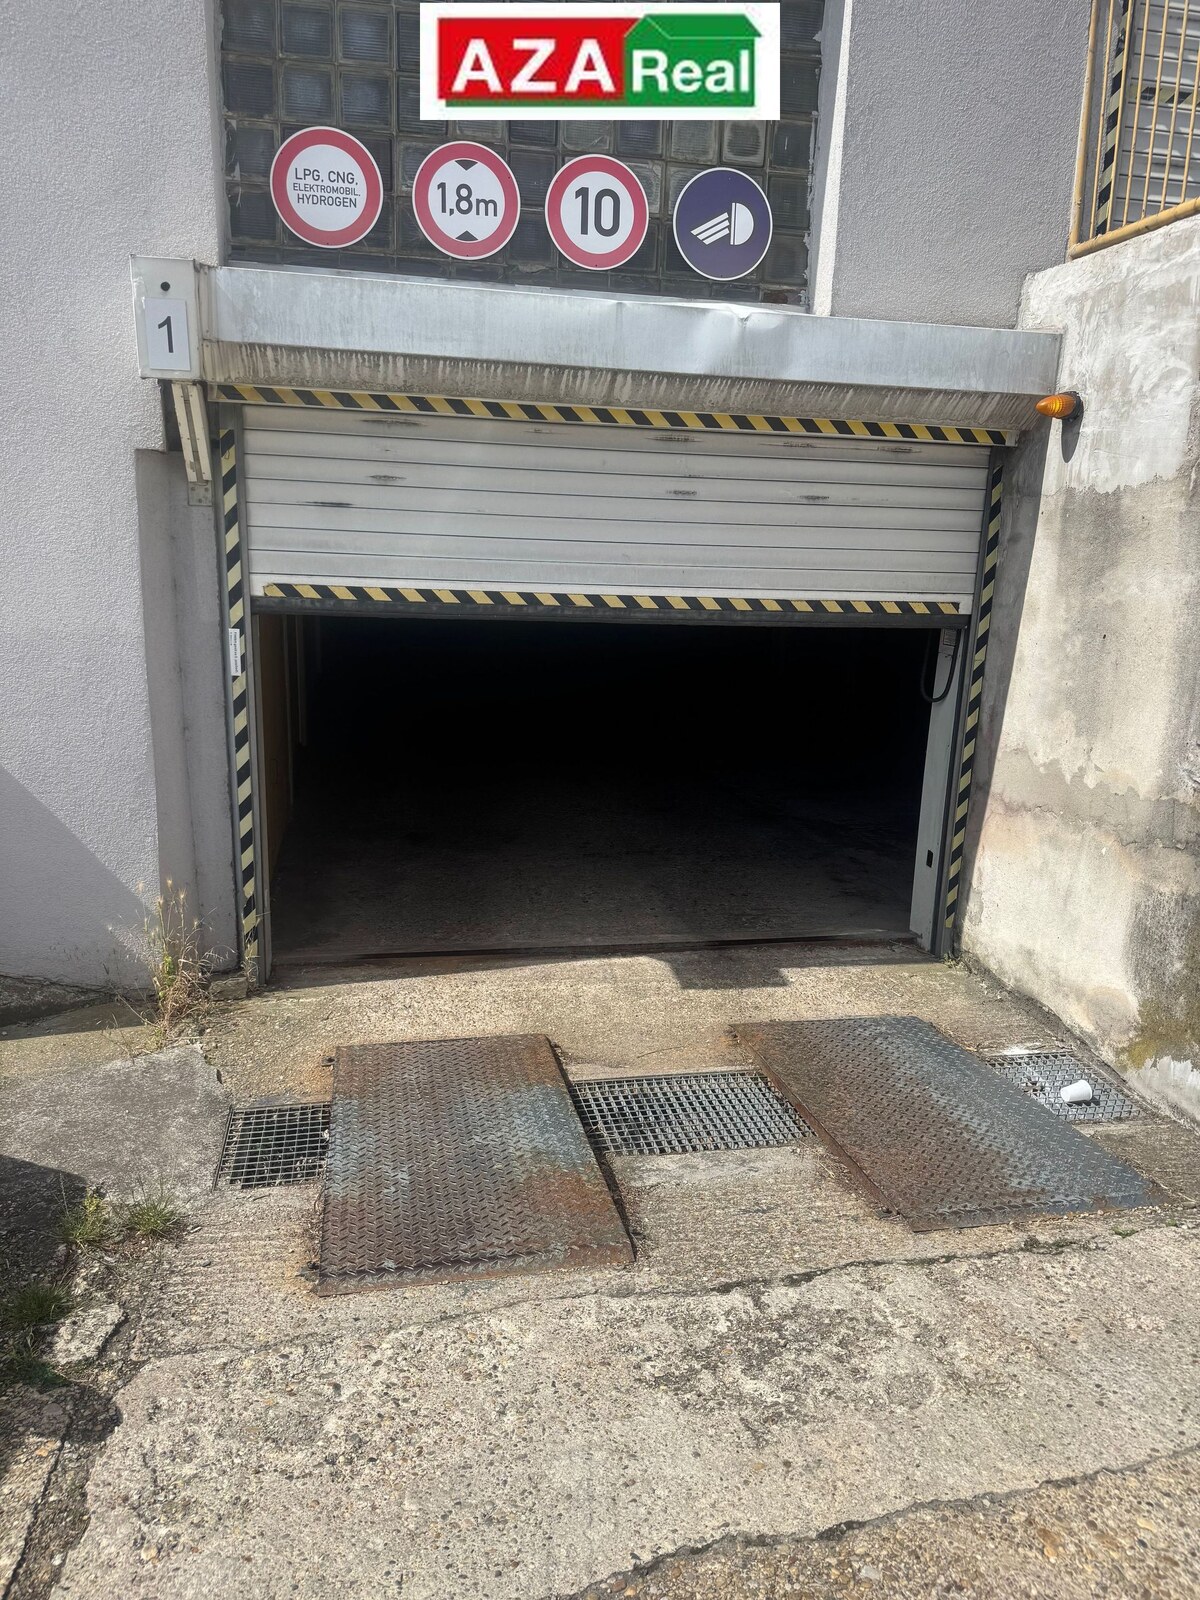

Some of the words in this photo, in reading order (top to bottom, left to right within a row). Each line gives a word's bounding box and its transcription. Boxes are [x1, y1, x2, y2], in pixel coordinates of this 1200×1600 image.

[297, 193, 357, 208] HYDROGEN
[437, 182, 497, 217] 1,8m
[574, 187, 620, 237] 10
[157, 315, 174, 353] 1
